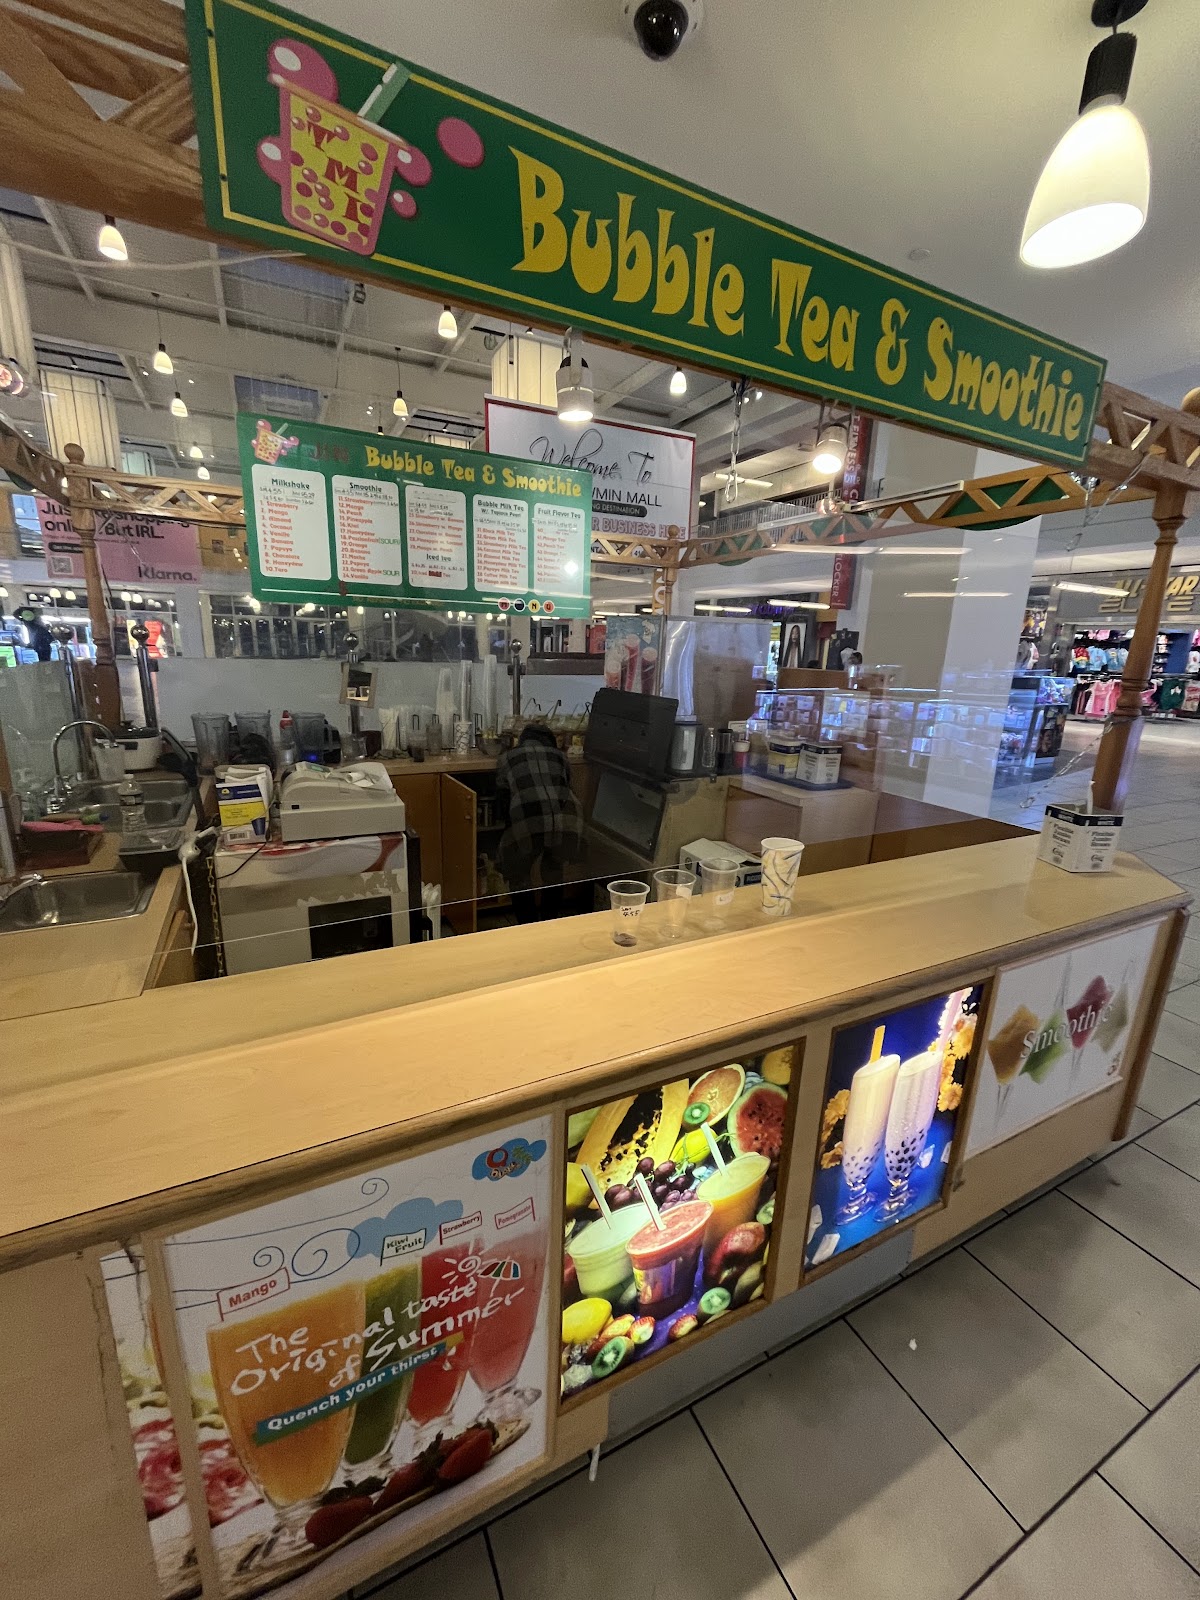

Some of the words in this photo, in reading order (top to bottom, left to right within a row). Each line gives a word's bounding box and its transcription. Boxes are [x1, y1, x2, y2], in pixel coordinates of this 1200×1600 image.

[508, 145, 744, 336] Bubble
[771, 258, 860, 371] Tea
[875, 298, 910, 386] &
[923, 317, 1083, 441] Smoothie
[365, 445, 435, 476] Bubble
[441, 458, 475, 482] Tea
[482, 465, 496, 483] &
[501, 467, 582, 497] Smoothie
[628, 452, 655, 486] To
[271, 479, 310, 489] Milkshake
[350, 482, 382, 493] Smoothie
[267, 501, 299, 511] Strawberry
[477, 500, 498, 509] Bubble
[514, 504, 524, 512] Tea
[627, 491, 662, 507] MALL
[42, 501, 72, 515] Jus
[552, 510, 569, 518] Flavor
[105, 523, 134, 537] But
[137, 525, 164, 539] IRL.
[603, 518, 656, 536] BUSINESS
[660, 523, 686, 539] HE
[426, 553, 439, 561] Iced
[832, 557, 843, 597] LOCKER
[442, 1216, 480, 1235] Strawberry
[386, 1236, 409, 1249] Kiwi
[395, 1237, 423, 1253] Fruit
[228, 1277, 278, 1308] Mango
[230, 1307, 395, 1396] Original
[400, 1280, 478, 1320] taste
[236, 1326, 309, 1364] The
[329, 1354, 361, 1388] of
[366, 1287, 525, 1372] Summer
[267, 1393, 340, 1431] Quench
[344, 1371, 386, 1402] your
